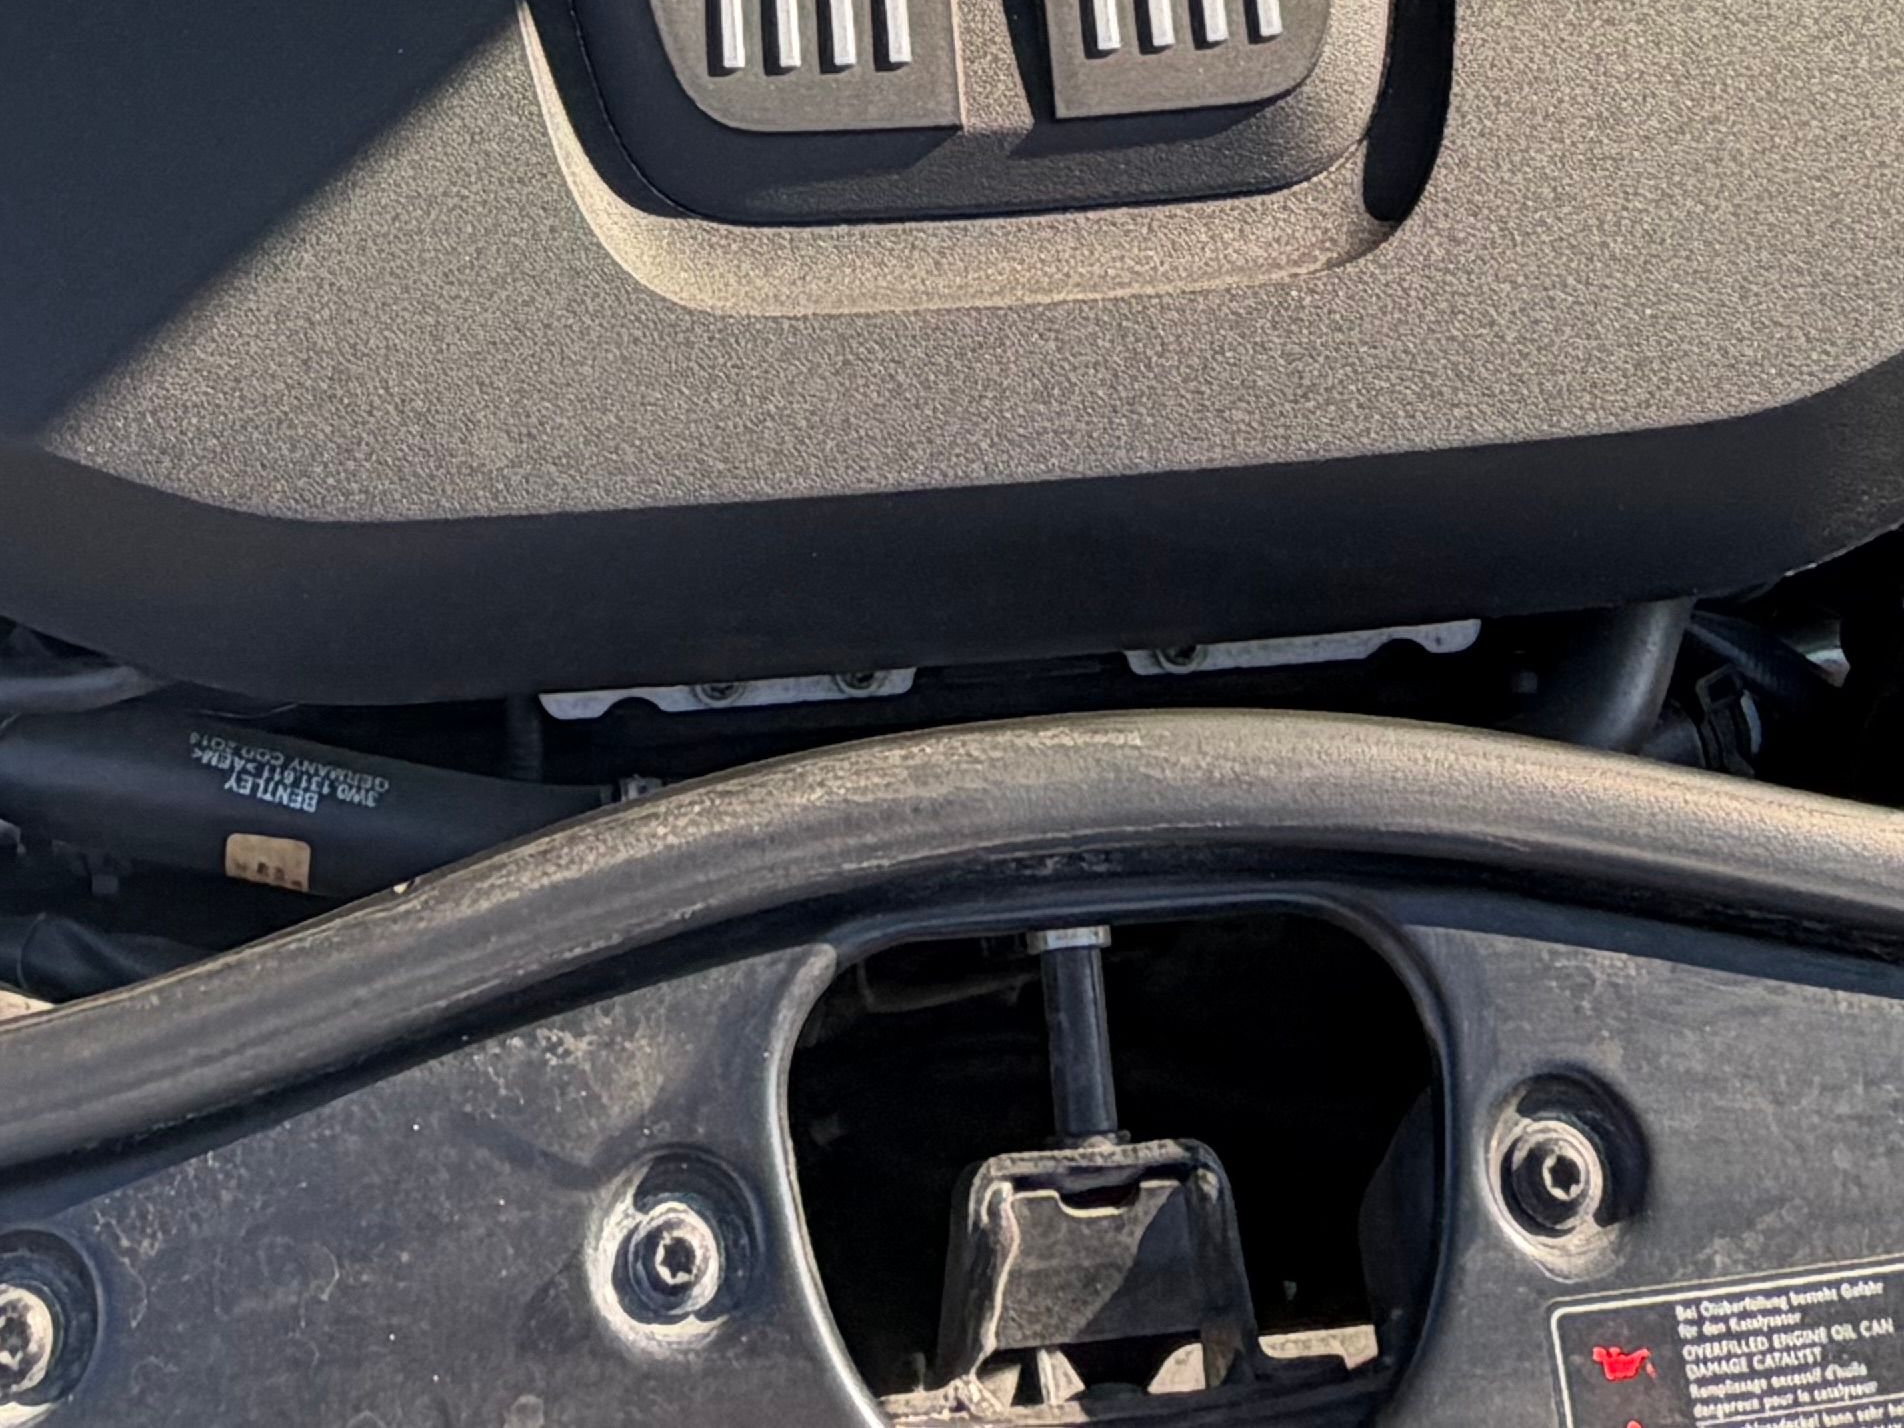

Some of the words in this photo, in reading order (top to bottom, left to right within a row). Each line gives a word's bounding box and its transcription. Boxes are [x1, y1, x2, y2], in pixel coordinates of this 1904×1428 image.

[224, 771, 319, 813] BENTLEY
[287, 757, 390, 793] GERMANY
[1682, 1336, 1770, 1361] OVERFILLED
[1772, 1326, 1829, 1349] ENGINE
[1831, 1323, 1858, 1341] OIL
[1859, 1317, 1895, 1338] CAN
[1685, 1357, 1750, 1380] DAMAGE
[1752, 1347, 1822, 1373] CATALYST
